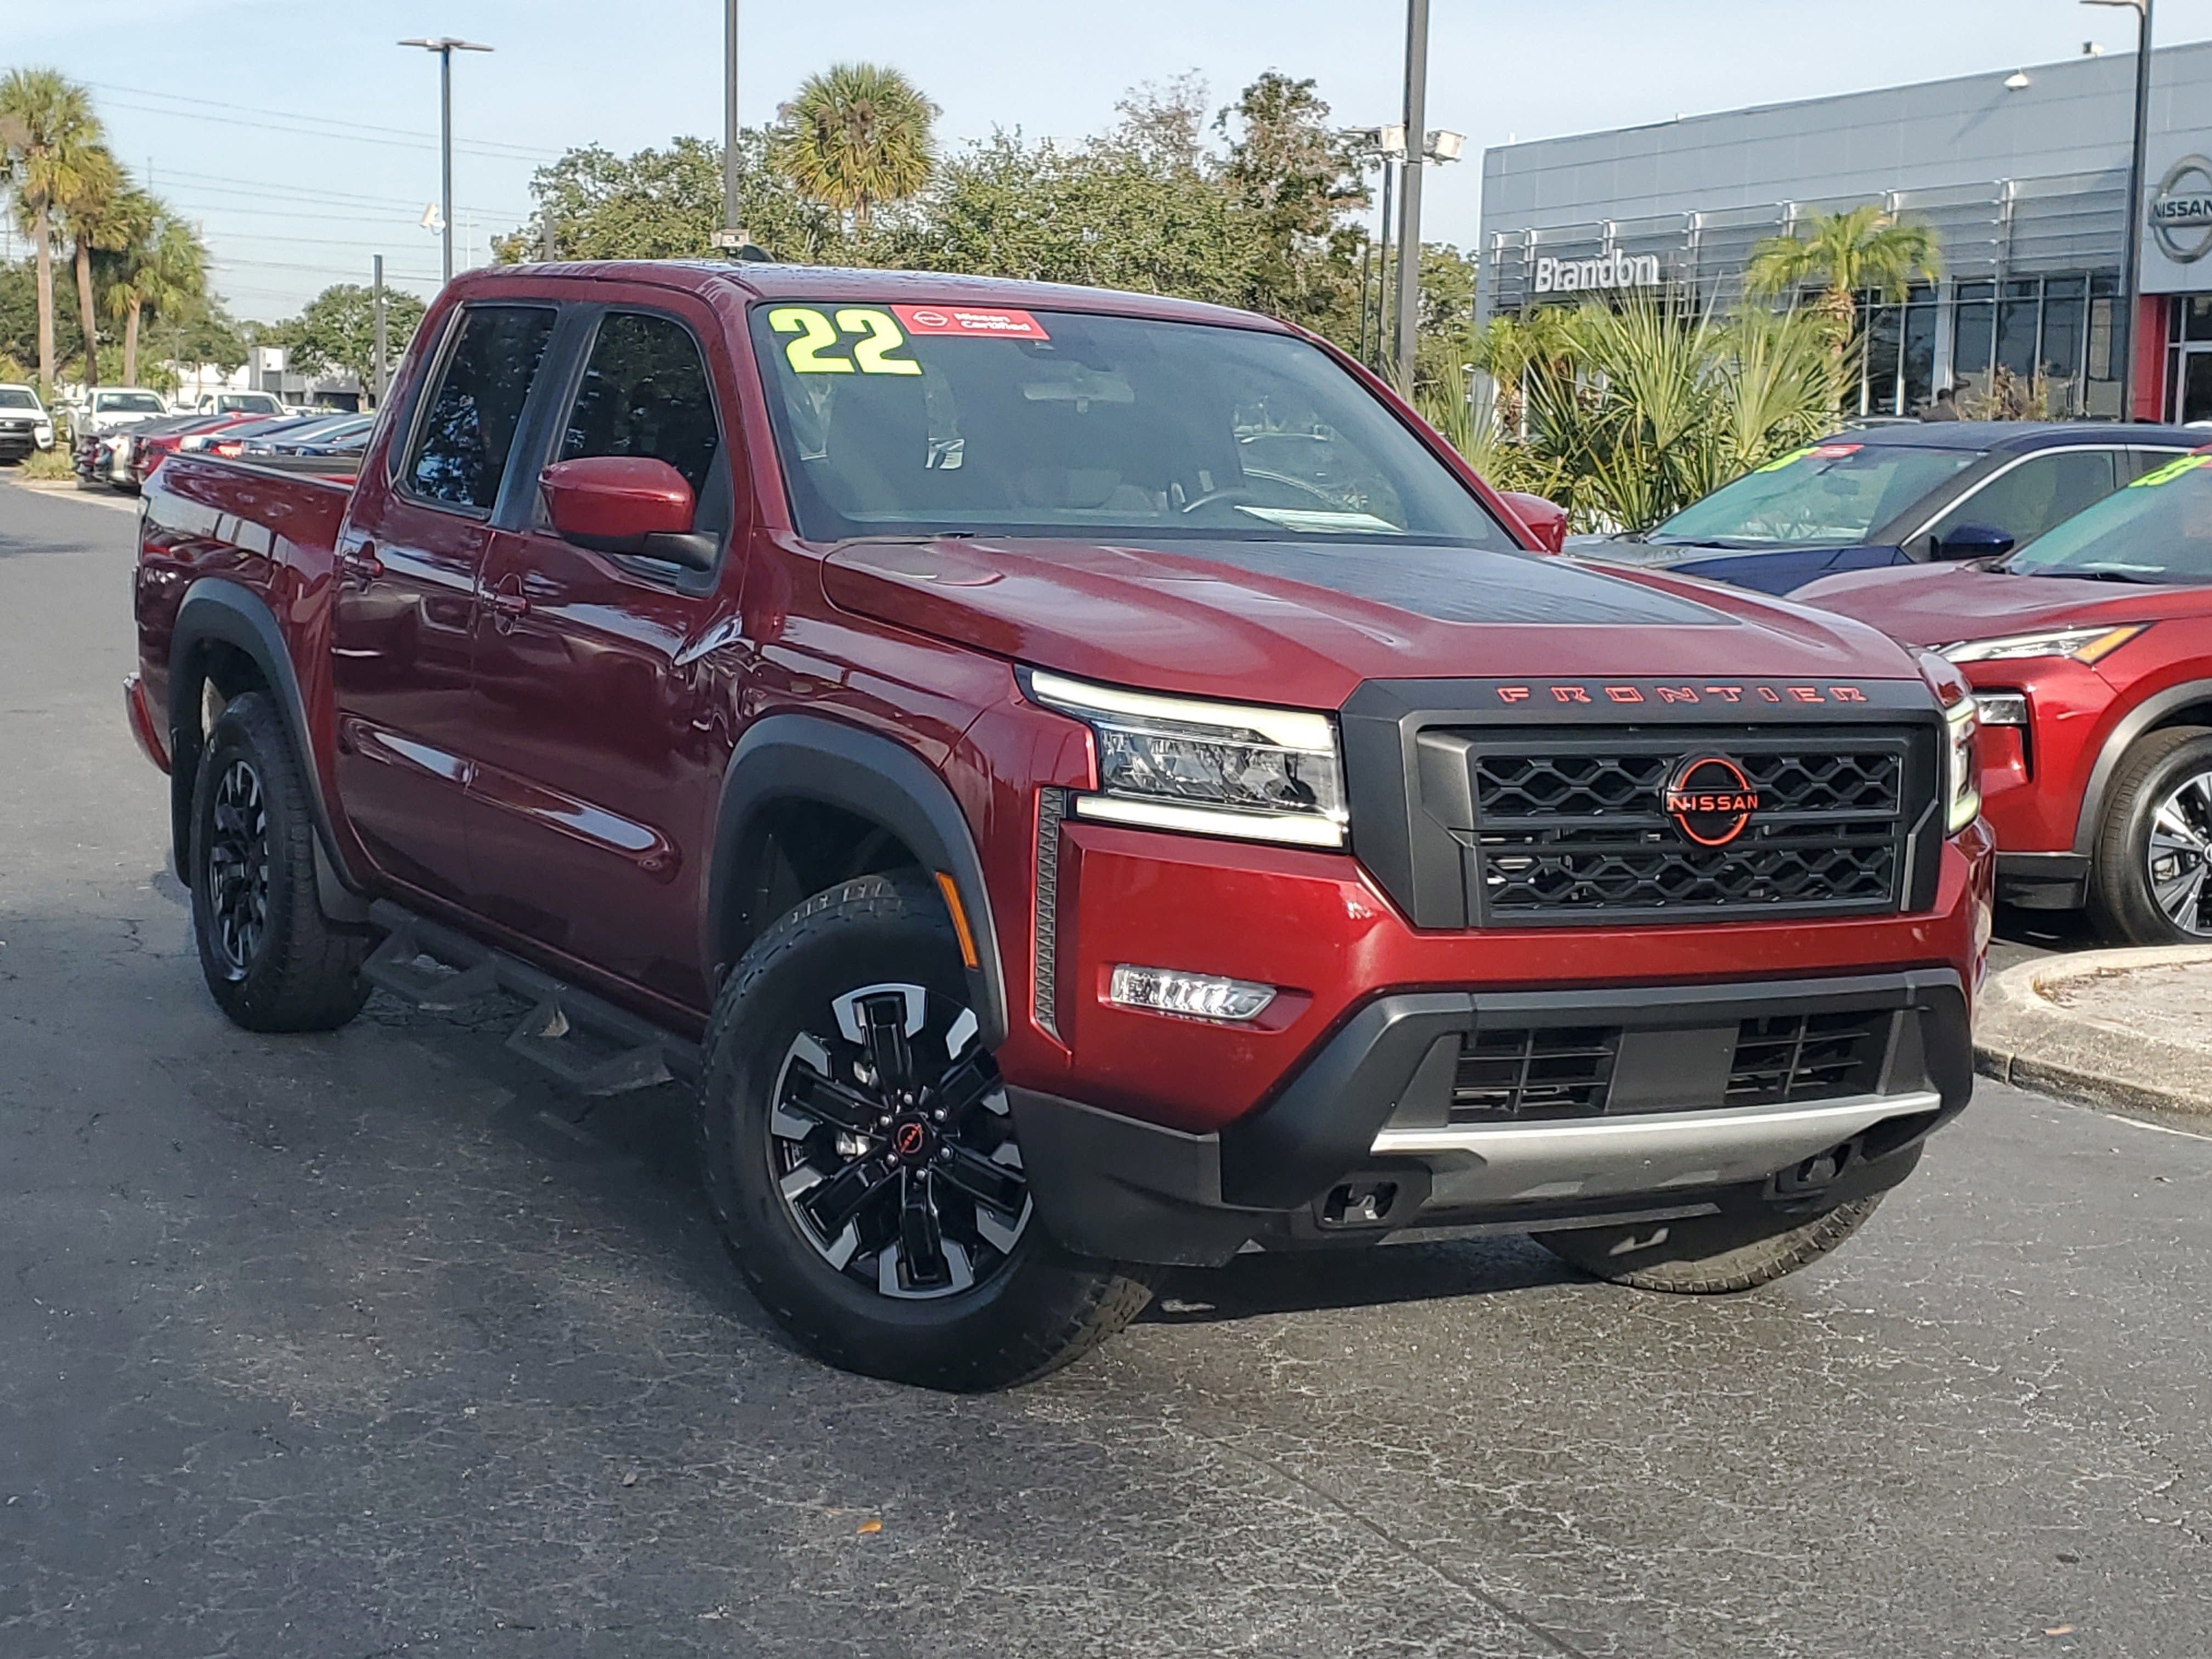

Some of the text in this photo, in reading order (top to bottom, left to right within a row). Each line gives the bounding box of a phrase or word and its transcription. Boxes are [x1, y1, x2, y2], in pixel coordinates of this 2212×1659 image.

[2153, 199, 2212, 218] NISSAN
[1536, 248, 1660, 292] Brandon
[768, 307, 923, 375] 22
[1494, 685, 1868, 704] FRONTIER
[1668, 794, 1758, 811] NISSAN
